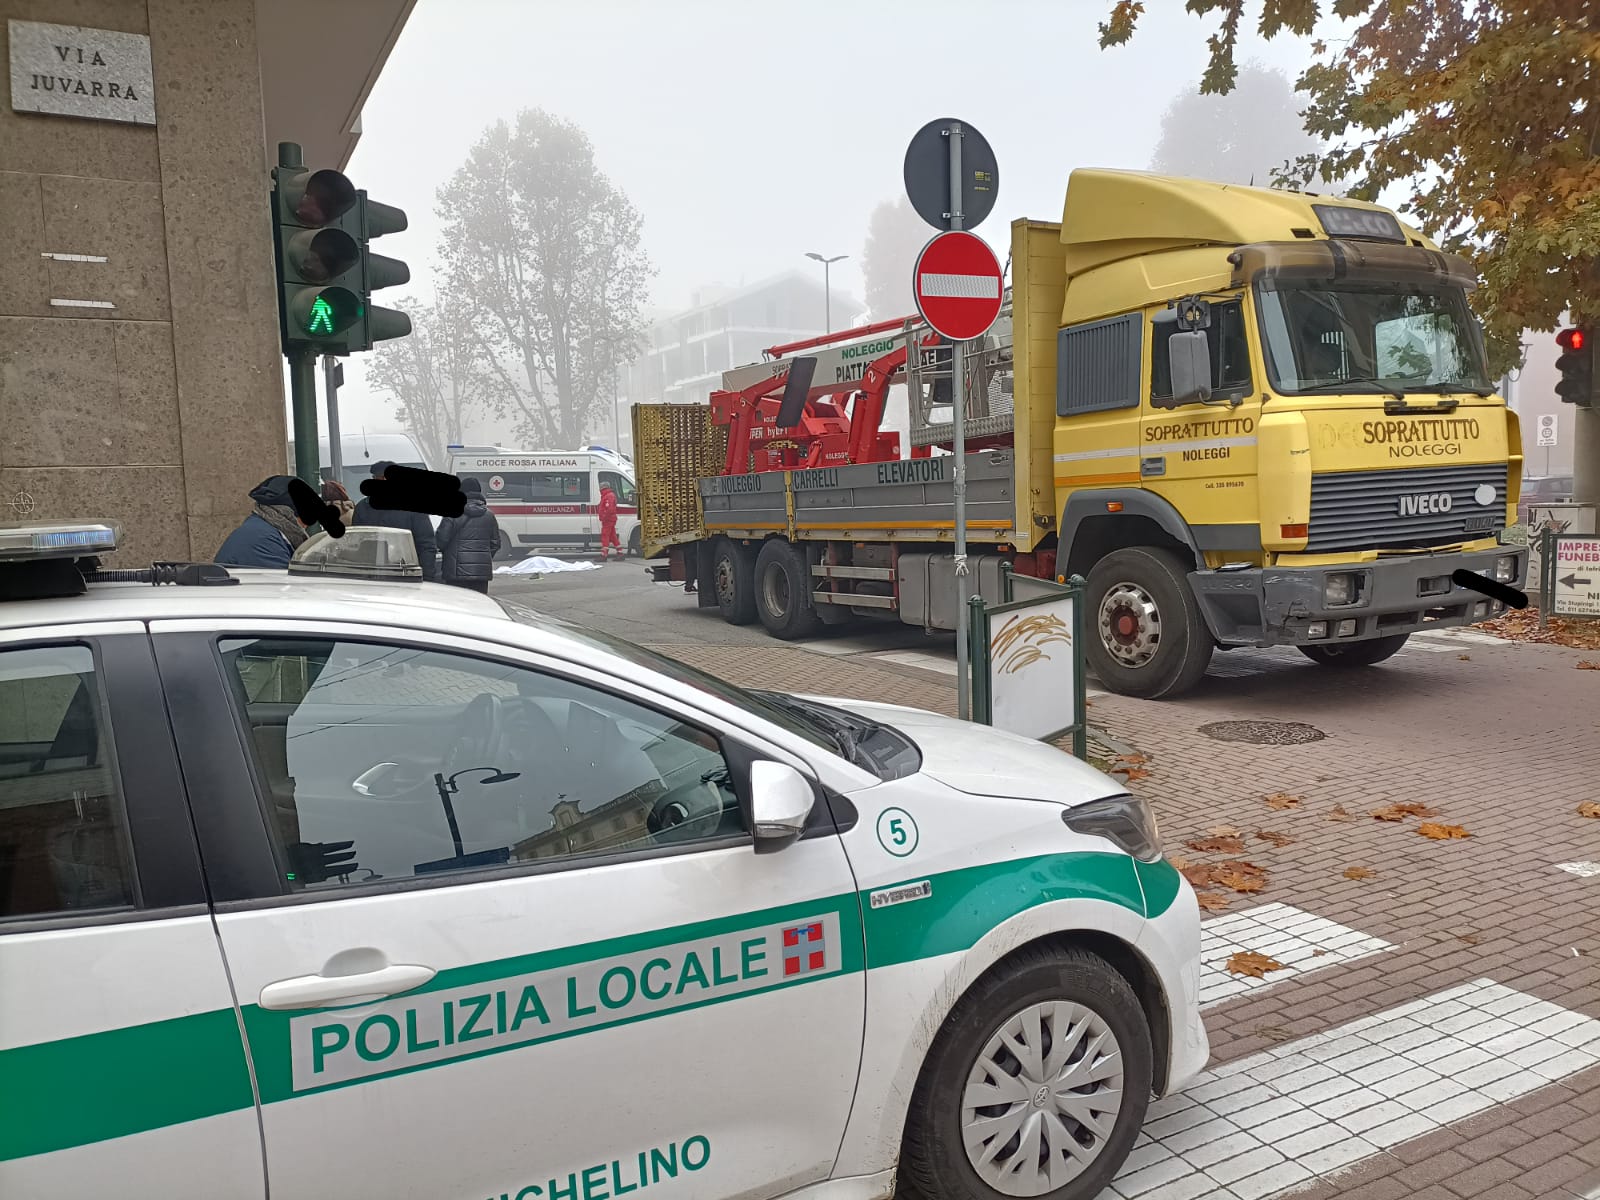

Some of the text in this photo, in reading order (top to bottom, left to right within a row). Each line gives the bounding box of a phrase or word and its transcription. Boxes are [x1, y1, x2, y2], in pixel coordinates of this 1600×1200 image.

[55, 46, 106, 66] VIA
[31, 74, 138, 101] JUVARRA
[841, 340, 894, 359] NOLEGGIO
[1145, 417, 1254, 441] SOPRATTUTTO
[1362, 418, 1480, 444] SOPRATTUTTO
[1183, 447, 1230, 461] NOLEGGI
[1389, 443, 1461, 458] NOLEGGI
[476, 459, 506, 467] CROCE
[720, 458, 944, 493] NOLEGGIO CARRELLI ELEVATORI
[1399, 493, 1451, 516] IVECO
[1558, 542, 1600, 551] IMPRE
[890, 818, 907, 846] 5
[312, 938, 768, 1073] POLIZIA LOCALE
